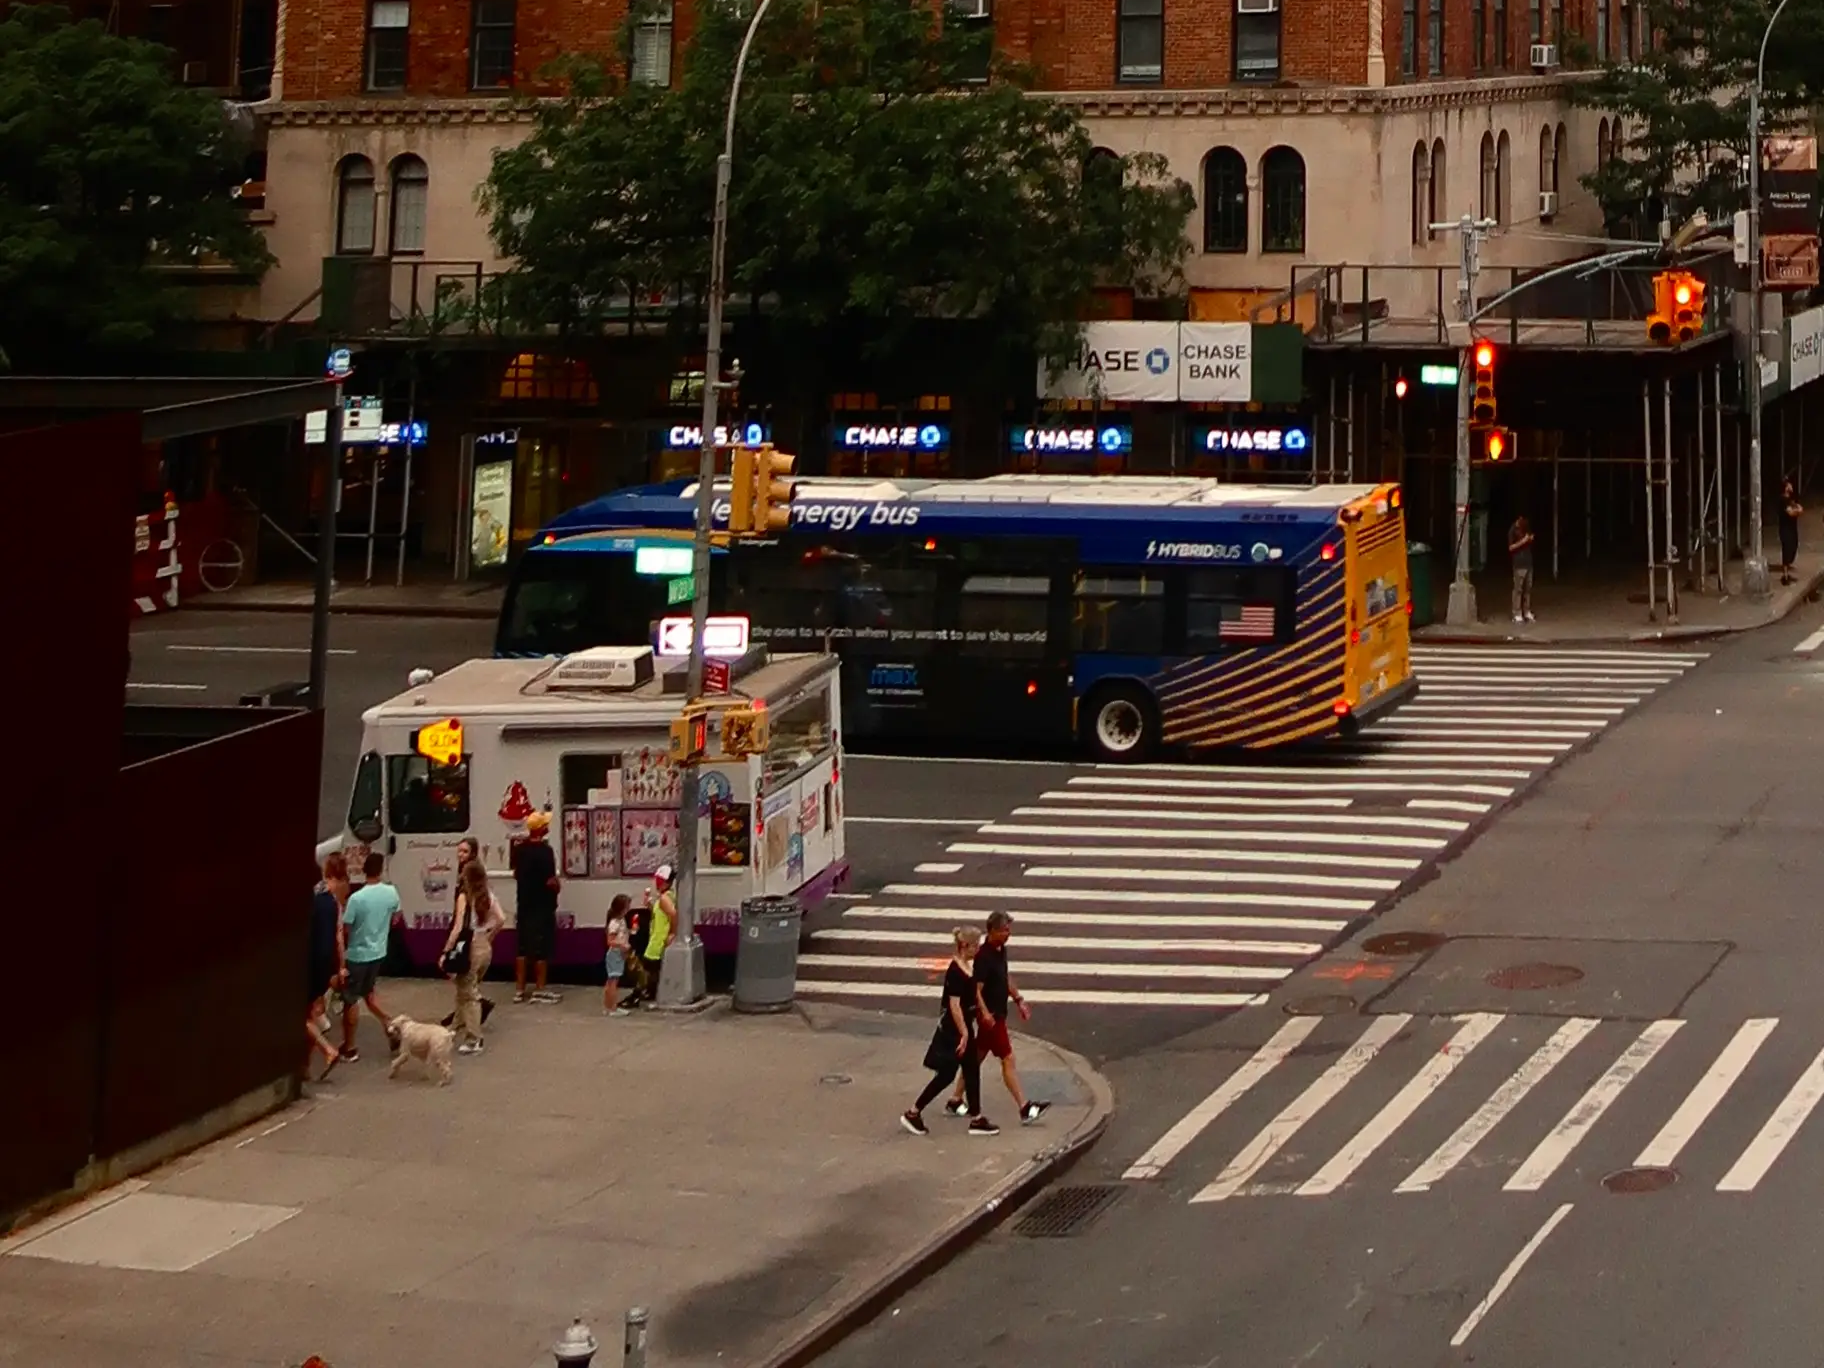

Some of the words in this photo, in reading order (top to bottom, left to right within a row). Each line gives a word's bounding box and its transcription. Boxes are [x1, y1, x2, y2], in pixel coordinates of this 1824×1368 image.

[1183, 343, 1247, 361] CHASE
[1188, 363, 1241, 380] BANK
[845, 426, 918, 446] CHASE
[1024, 428, 1094, 450] CHASE
[1207, 429, 1281, 450] CHASE
[870, 500, 920, 525] bus
[1157, 543, 1242, 559] HYBRIDBUS
